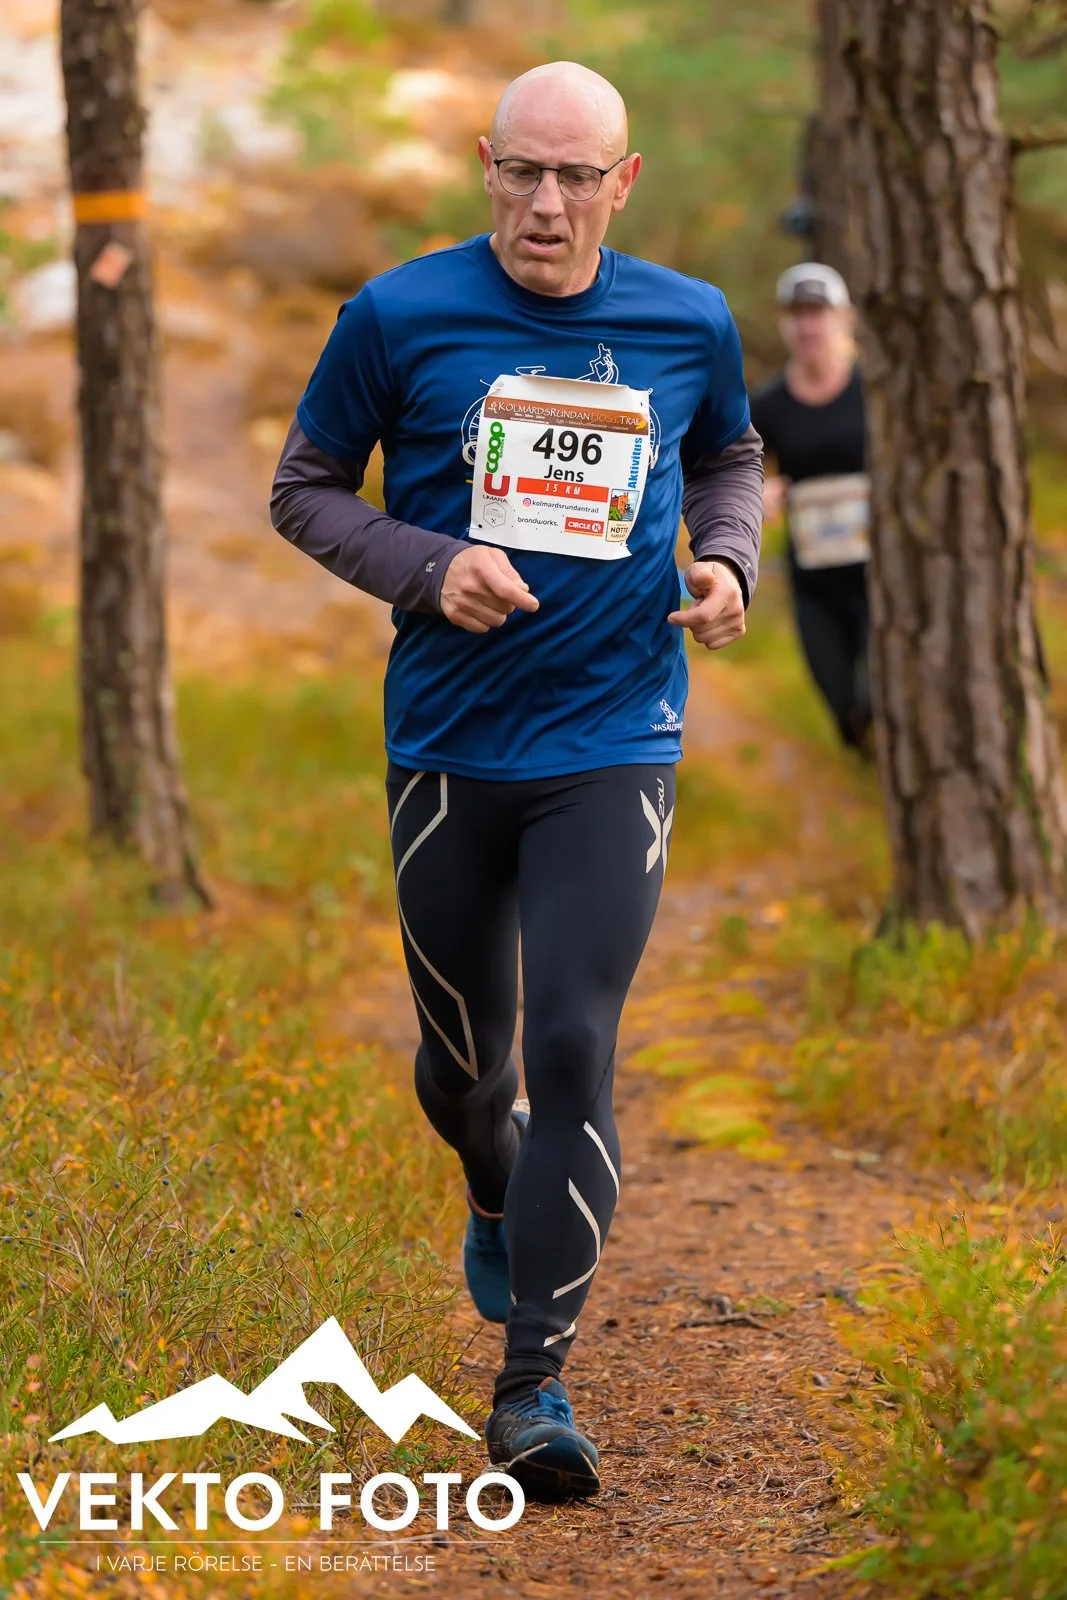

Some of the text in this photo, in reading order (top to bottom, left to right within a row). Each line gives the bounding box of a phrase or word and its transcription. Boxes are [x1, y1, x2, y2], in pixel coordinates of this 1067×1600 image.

[486, 422, 505, 473] coop
[532, 428, 603, 465] 496
[628, 437, 643, 489] Aktivitus
[544, 464, 584, 483] Jens
[483, 494, 508, 503] UMARA
[565, 485, 581, 496] KM
[532, 500, 599, 514] kolmardsrundantrail
[567, 521, 591, 530] CIRCLE
